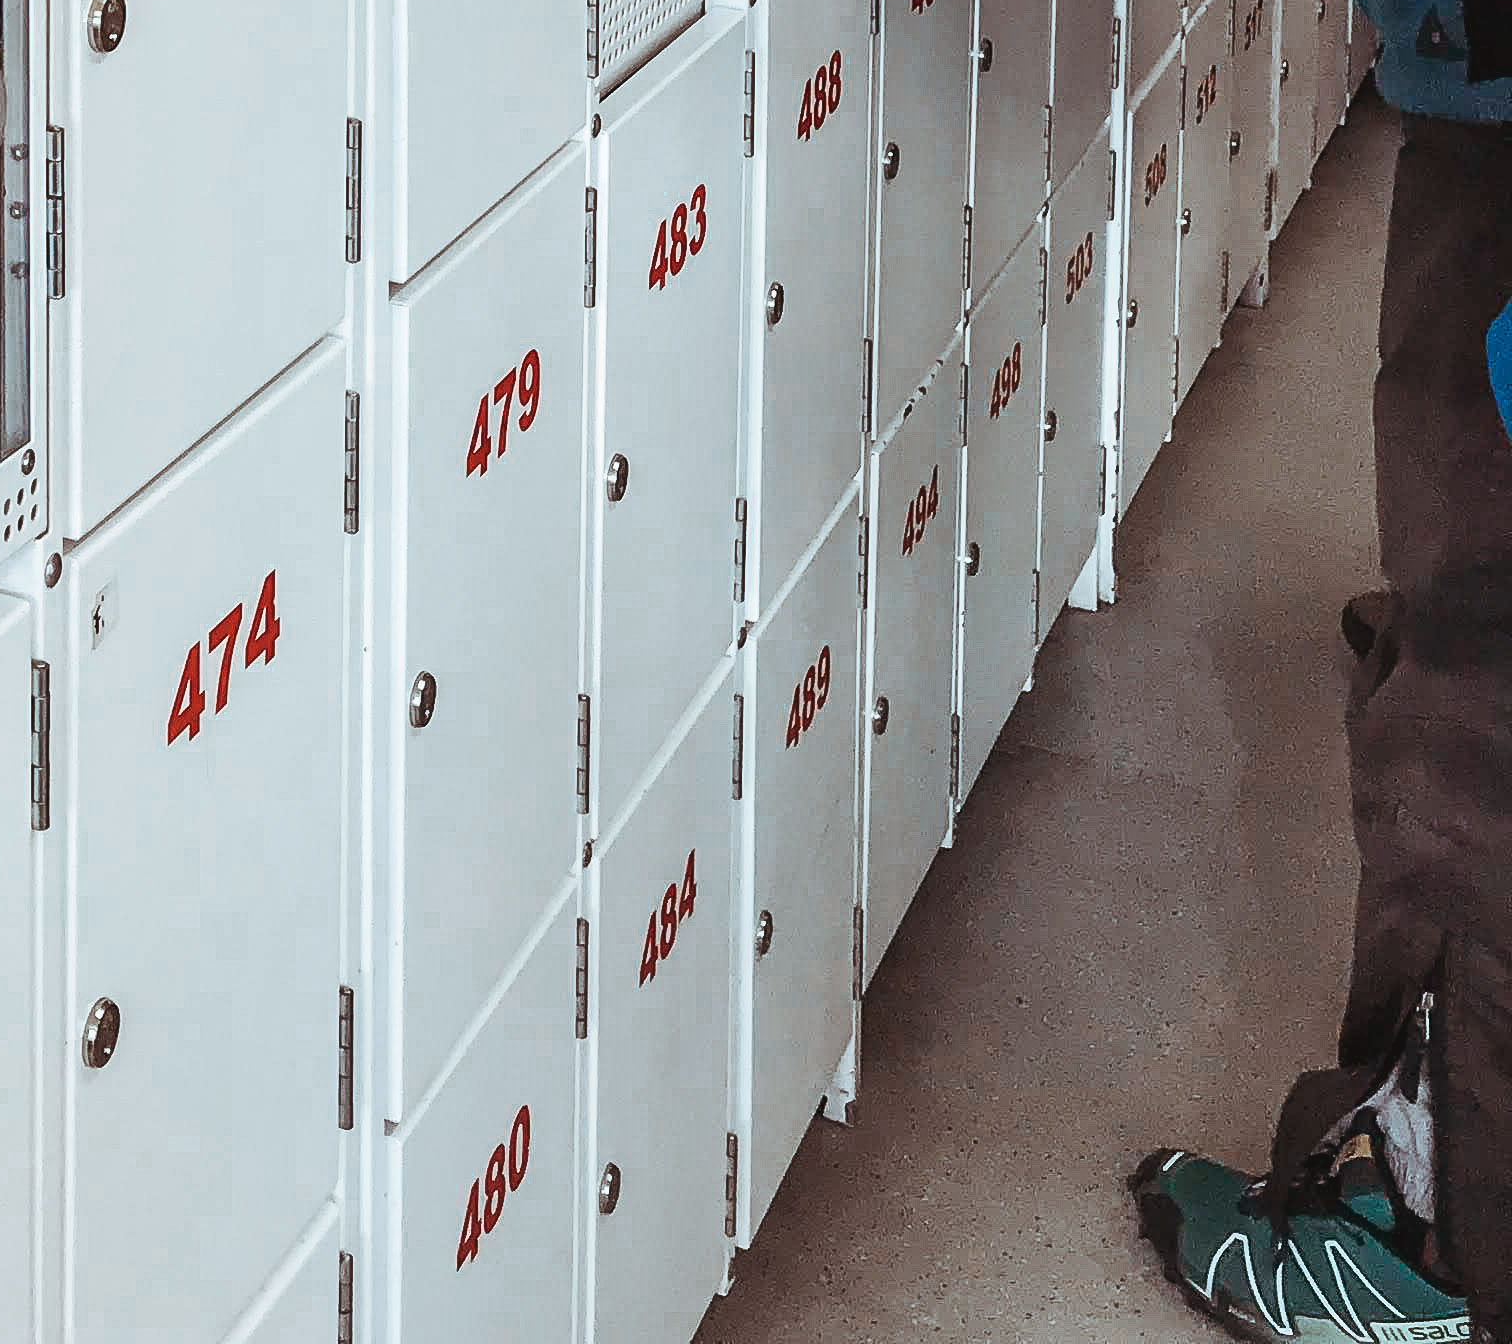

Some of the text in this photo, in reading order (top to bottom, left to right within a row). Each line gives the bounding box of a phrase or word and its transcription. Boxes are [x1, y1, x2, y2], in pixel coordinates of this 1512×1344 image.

[798, 50, 841, 142] 488
[649, 184, 706, 290] 483
[1066, 232, 1092, 304] 503
[466, 349, 540, 477] 479
[990, 342, 1020, 419] 498
[902, 464, 938, 555] 494
[168, 569, 280, 746] 474
[786, 645, 830, 749] 489
[640, 856, 697, 983] 484
[457, 1105, 530, 1272] 480
